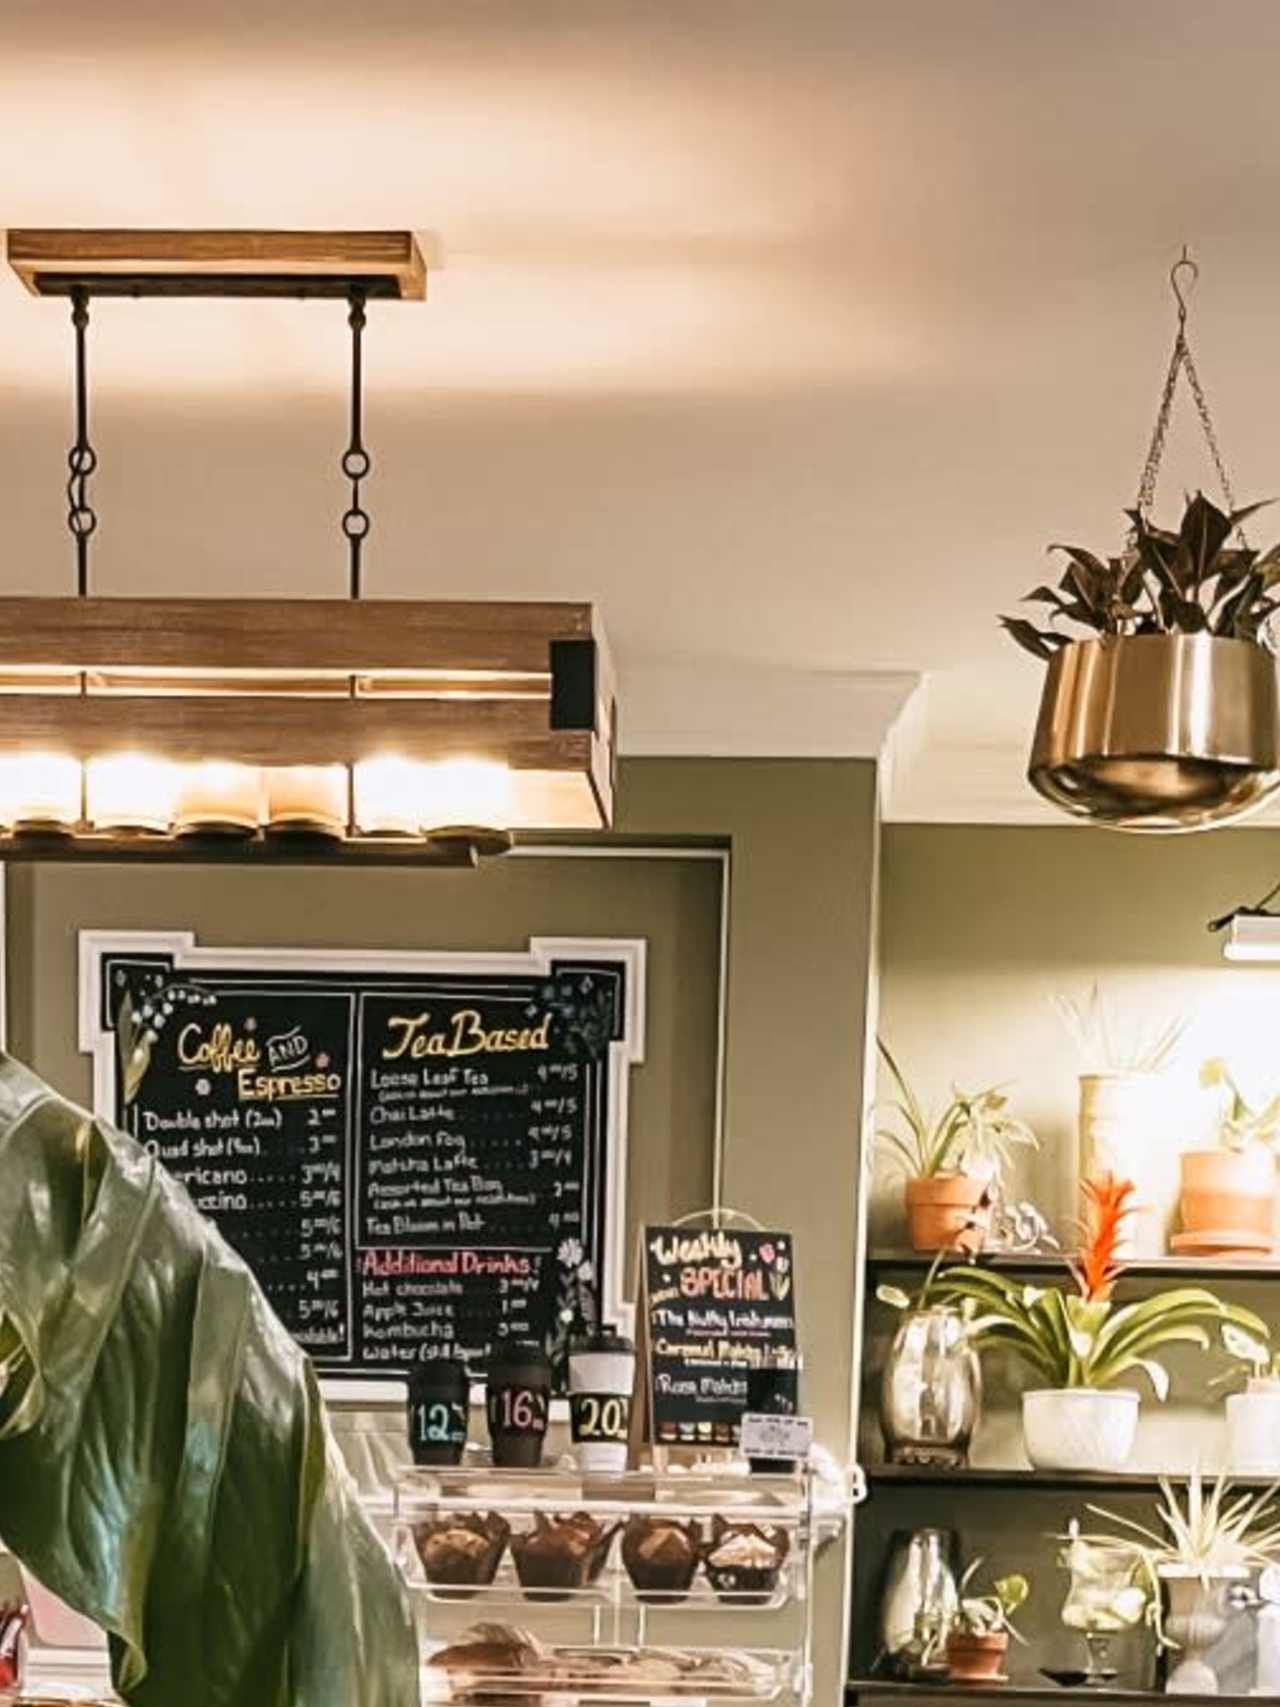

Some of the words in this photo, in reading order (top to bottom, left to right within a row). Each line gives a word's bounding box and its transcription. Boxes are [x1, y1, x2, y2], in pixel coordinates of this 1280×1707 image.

[177, 1023, 261, 1073] Coffee
[269, 1035, 309, 1066] AND
[381, 1013, 446, 1059] Tea
[446, 1010, 554, 1057] Based
[238, 1068, 342, 1101] Espresso
[142, 1111, 203, 1132] Double
[204, 1108, 241, 1129] shot
[191, 1137, 225, 1158] shot
[363, 1250, 458, 1276] Additional
[418, 1403, 451, 1442] 12
[503, 1390, 533, 1429] 16
[578, 1397, 620, 1437] 20
